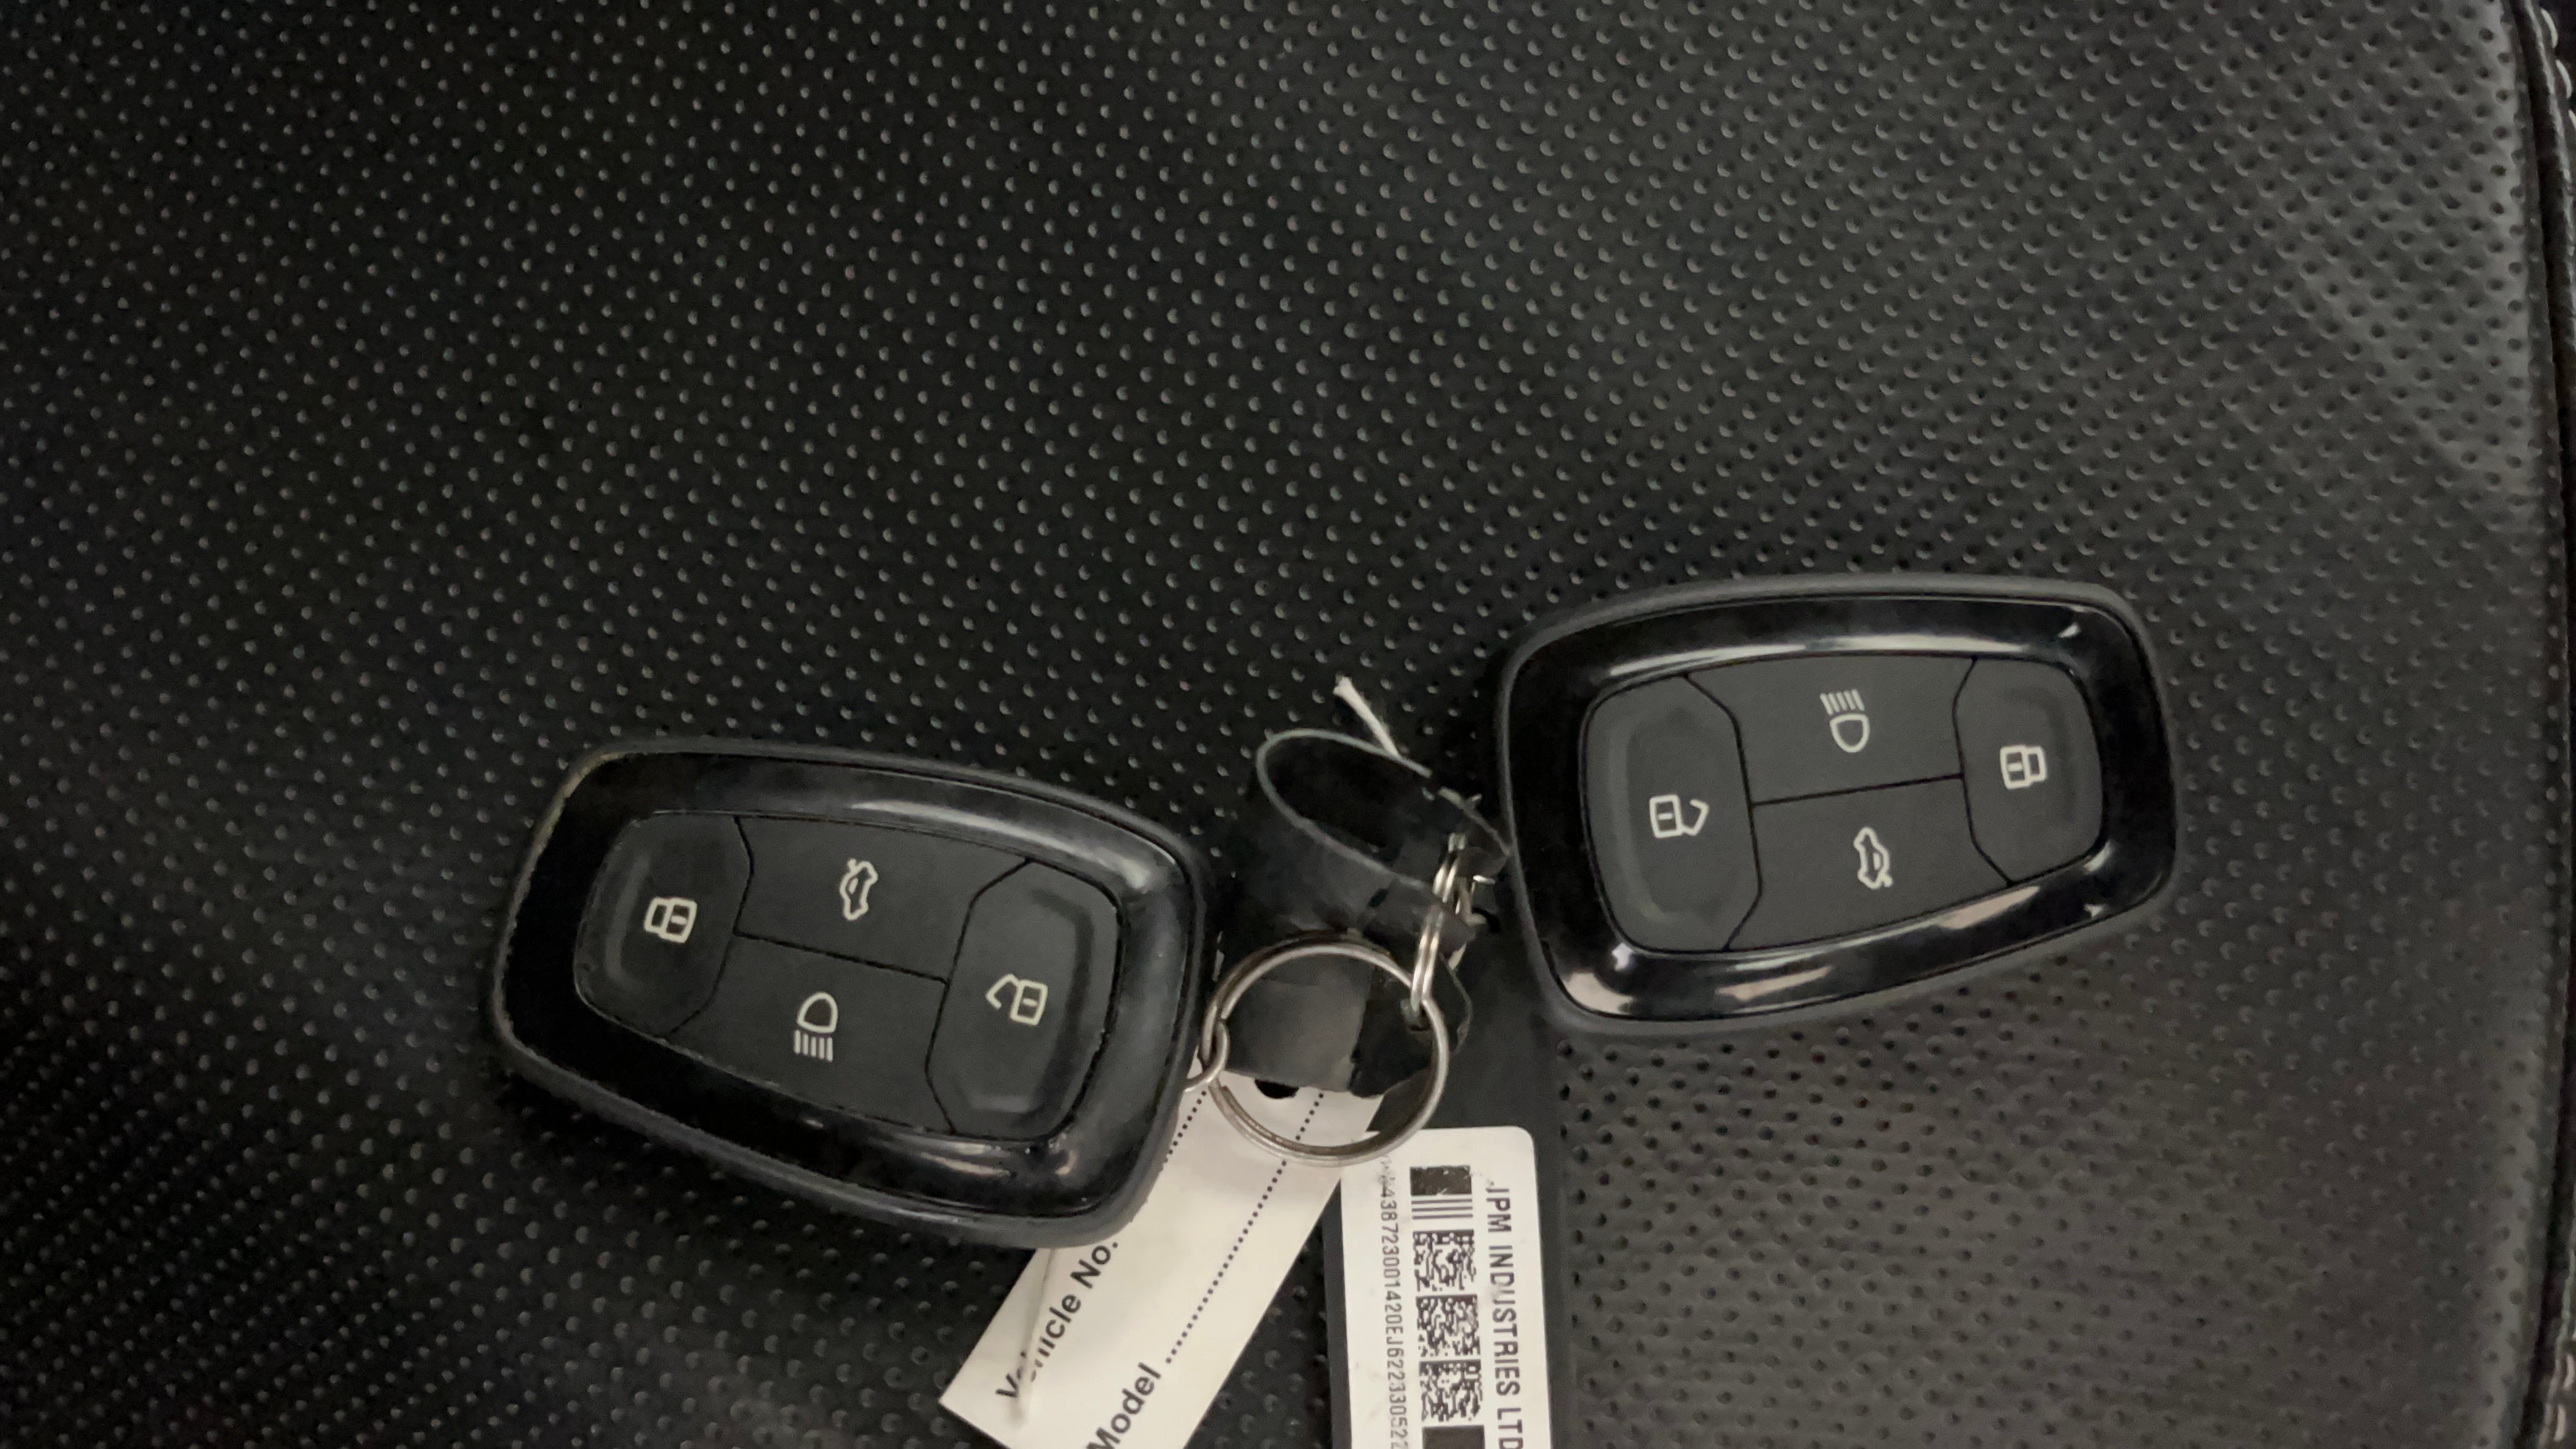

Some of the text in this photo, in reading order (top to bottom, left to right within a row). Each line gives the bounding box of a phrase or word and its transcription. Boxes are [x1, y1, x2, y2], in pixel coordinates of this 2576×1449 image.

[1069, 1242, 1118, 1289] No.
[1486, 1181, 1524, 1449] JPM INDUSTRIES LTD
[1086, 1362, 1162, 1449] Model
